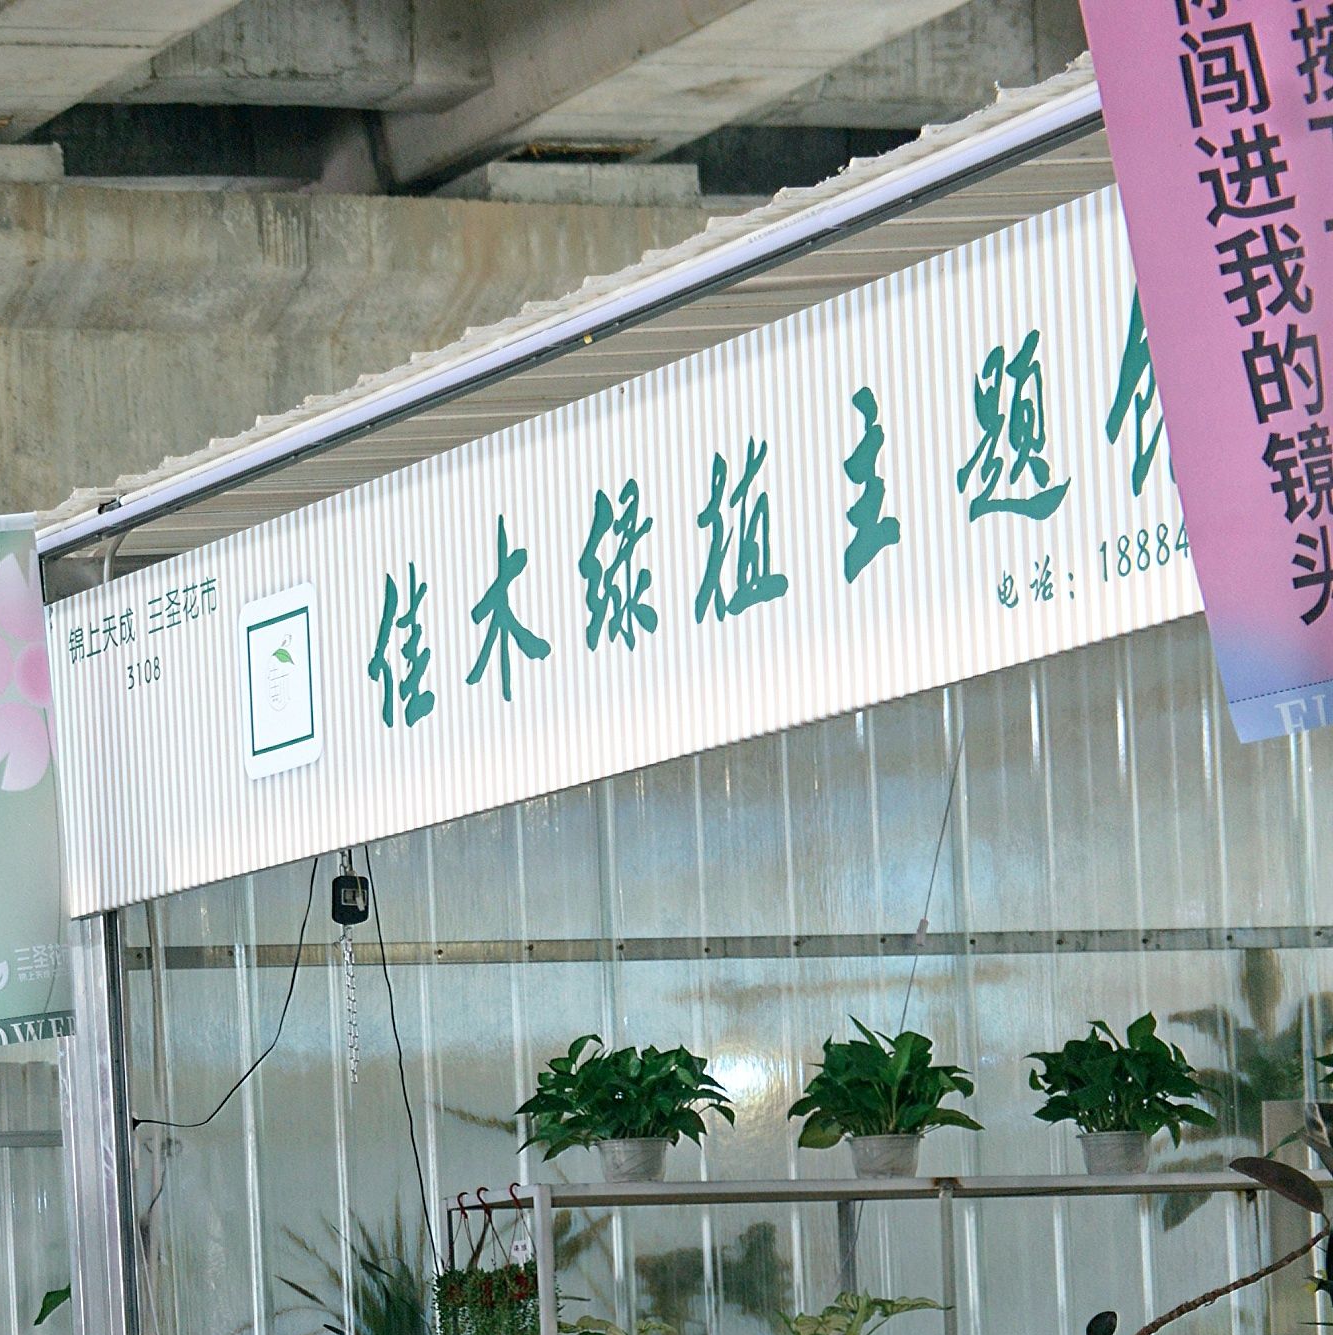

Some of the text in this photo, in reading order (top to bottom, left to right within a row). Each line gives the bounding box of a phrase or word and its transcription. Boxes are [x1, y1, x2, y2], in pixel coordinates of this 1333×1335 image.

[68, 577, 217, 664] 锦上天成 三圣花市
[127, 656, 161, 690] 3108
